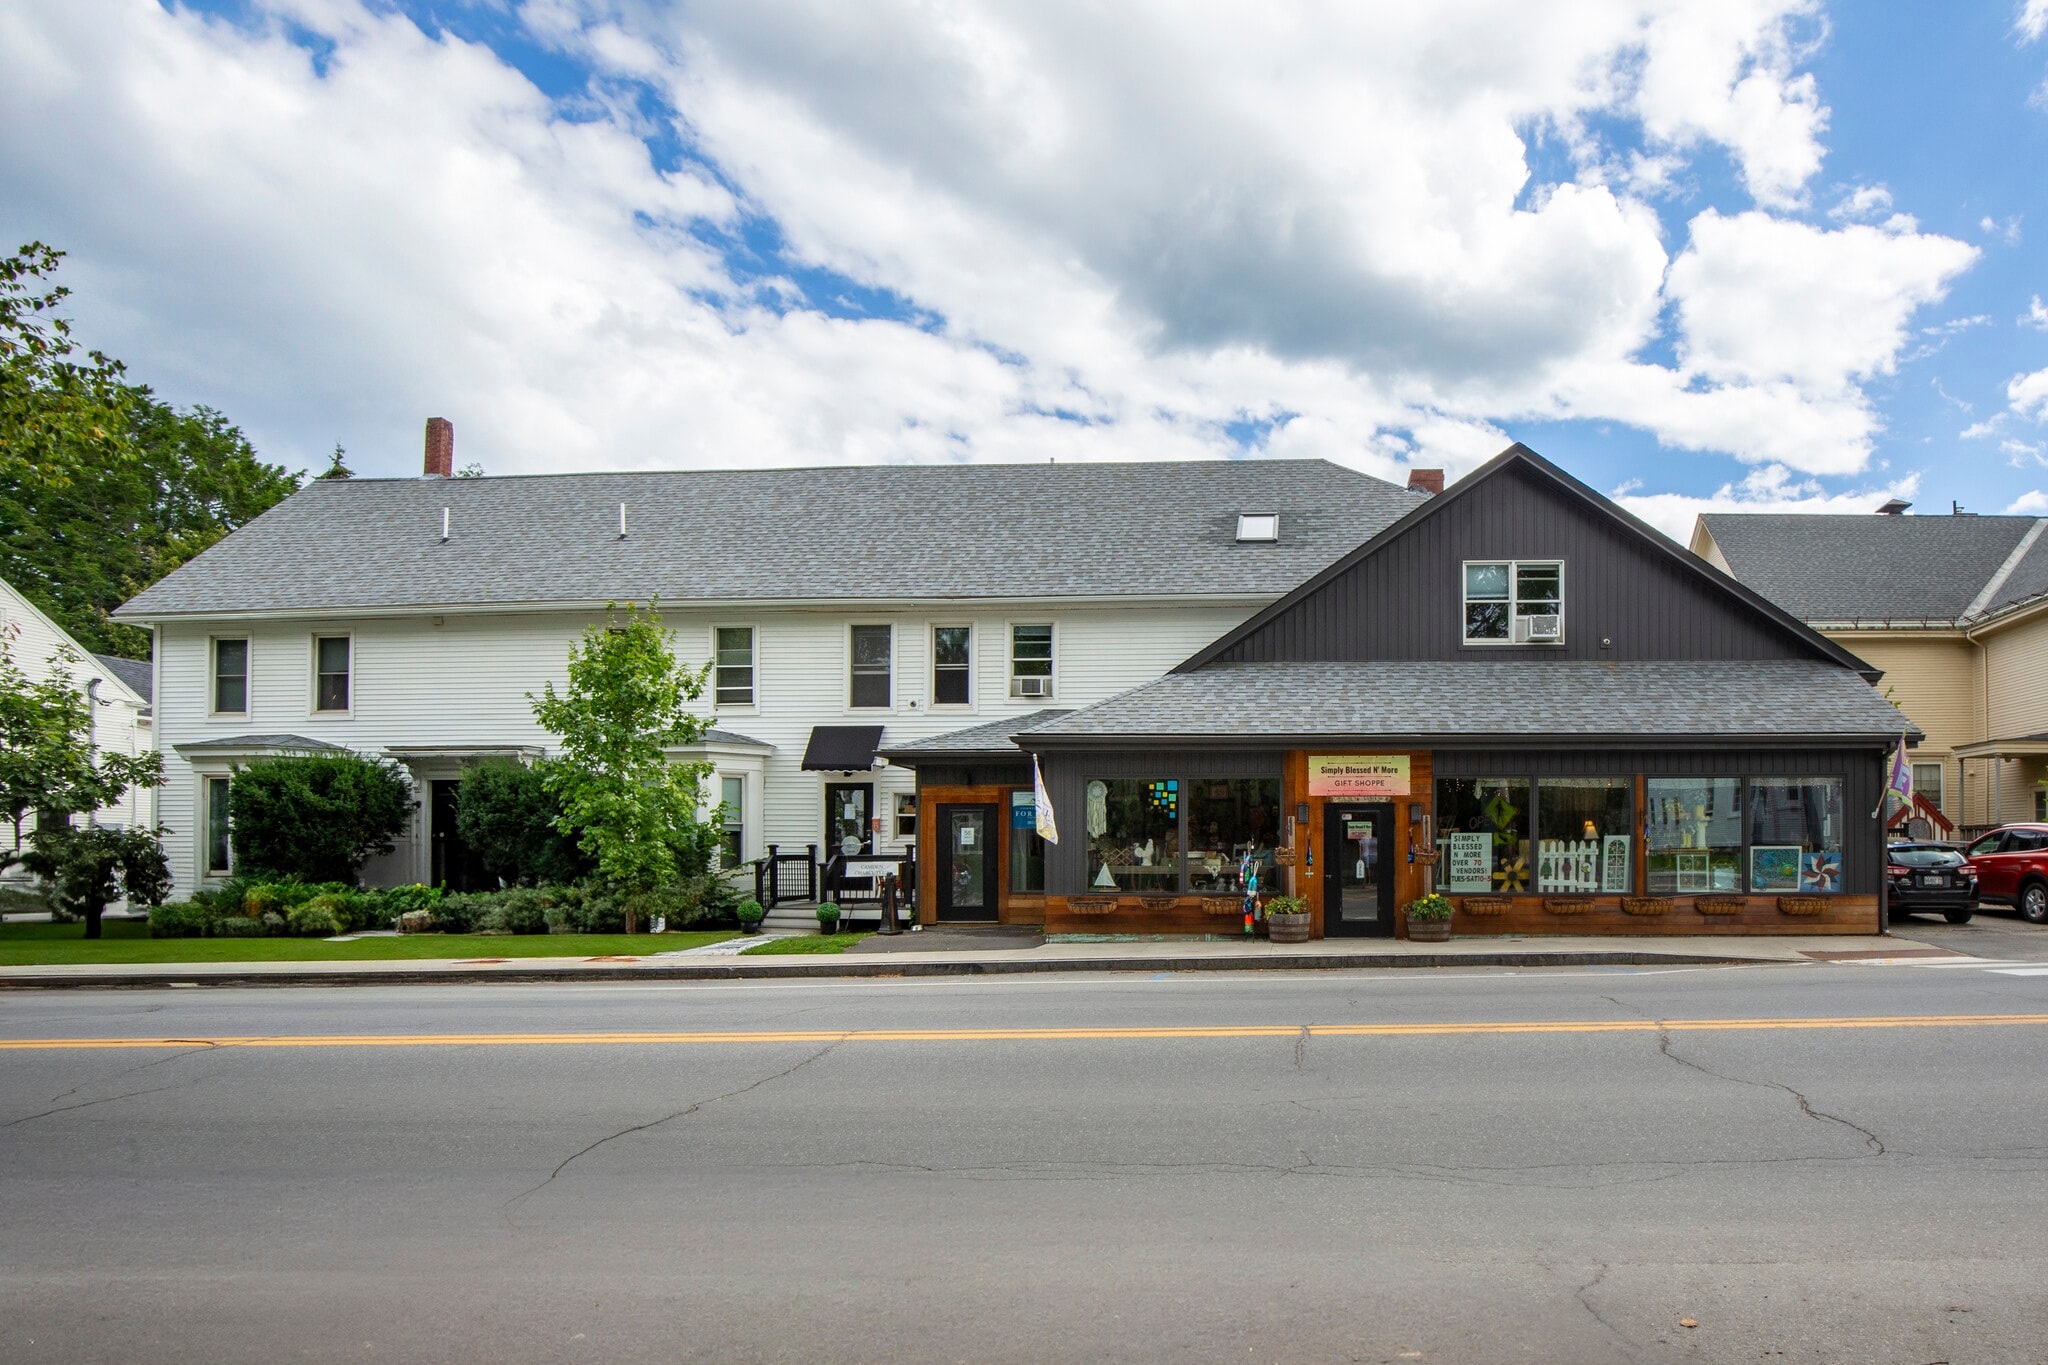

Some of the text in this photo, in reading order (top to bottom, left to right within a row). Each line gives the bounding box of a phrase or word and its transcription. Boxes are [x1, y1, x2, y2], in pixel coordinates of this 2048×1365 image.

[1320, 766, 1398, 775] Simply Blessed N' More
